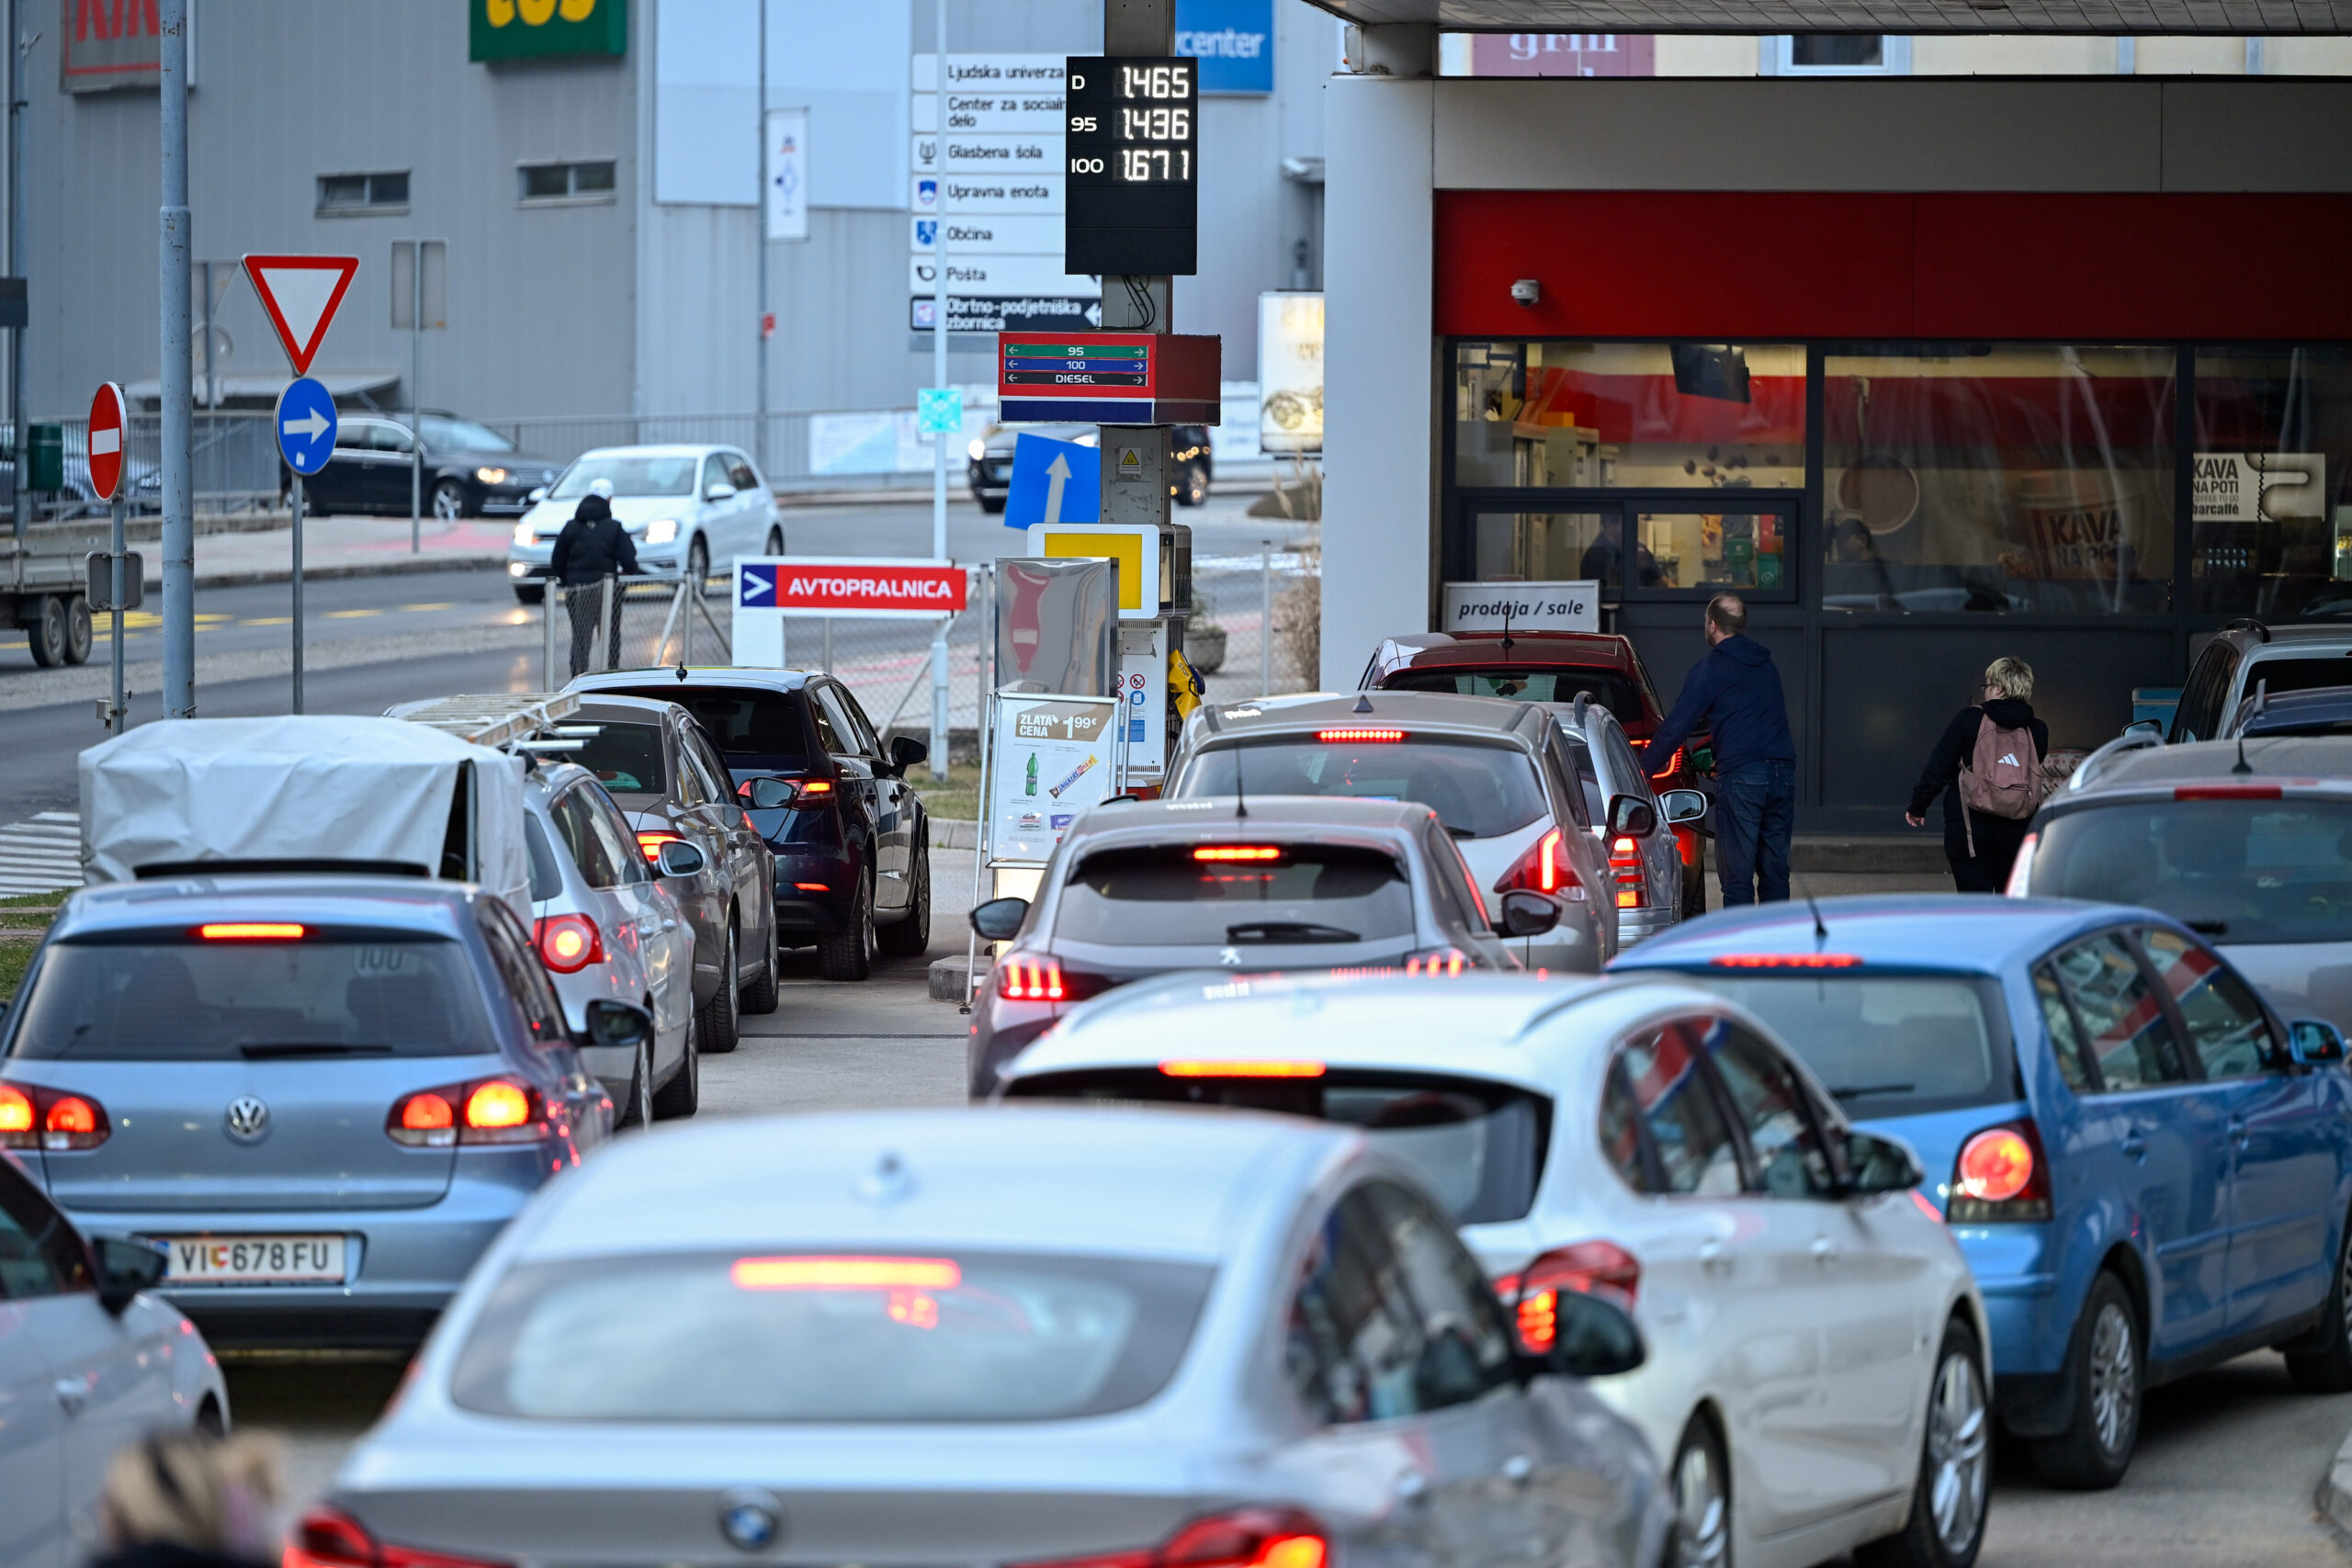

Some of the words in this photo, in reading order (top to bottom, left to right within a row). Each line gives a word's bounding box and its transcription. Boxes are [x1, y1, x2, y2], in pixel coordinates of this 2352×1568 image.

[947, 64, 1001, 83] Ljudska
[1005, 65, 1065, 79] univerza
[1071, 75, 1085, 89] D
[948, 96, 993, 111] Center
[1000, 99, 1017, 111] za
[948, 114, 977, 128] delo
[1070, 117, 1097, 131] 95
[948, 144, 1009, 159] Glasbena
[1015, 144, 1043, 159] šola
[1071, 158, 1104, 174] 100
[947, 185, 1004, 201] Upravna
[1011, 186, 1049, 198] enota
[946, 226, 993, 242] Občina
[946, 265, 987, 281] Pošta
[946, 315, 1006, 330] zbornica
[1068, 346, 1084, 356] 95
[1066, 361, 1086, 370] 100
[1056, 374, 1095, 384] DIESEL
[2193, 458, 2239, 479] KAVA
[2193, 480, 2209, 493] NA
[2211, 480, 2239, 493] POTI
[787, 578, 953, 598] AVTOPRALNICA
[1458, 600, 1529, 620] prodaja
[1547, 600, 1584, 615] sale
[1177, 662, 1190, 677] STOP
[1020, 714, 1053, 727] ZLATA
[1020, 725, 1049, 738] CENA
[180, 1244, 208, 1273] VI
